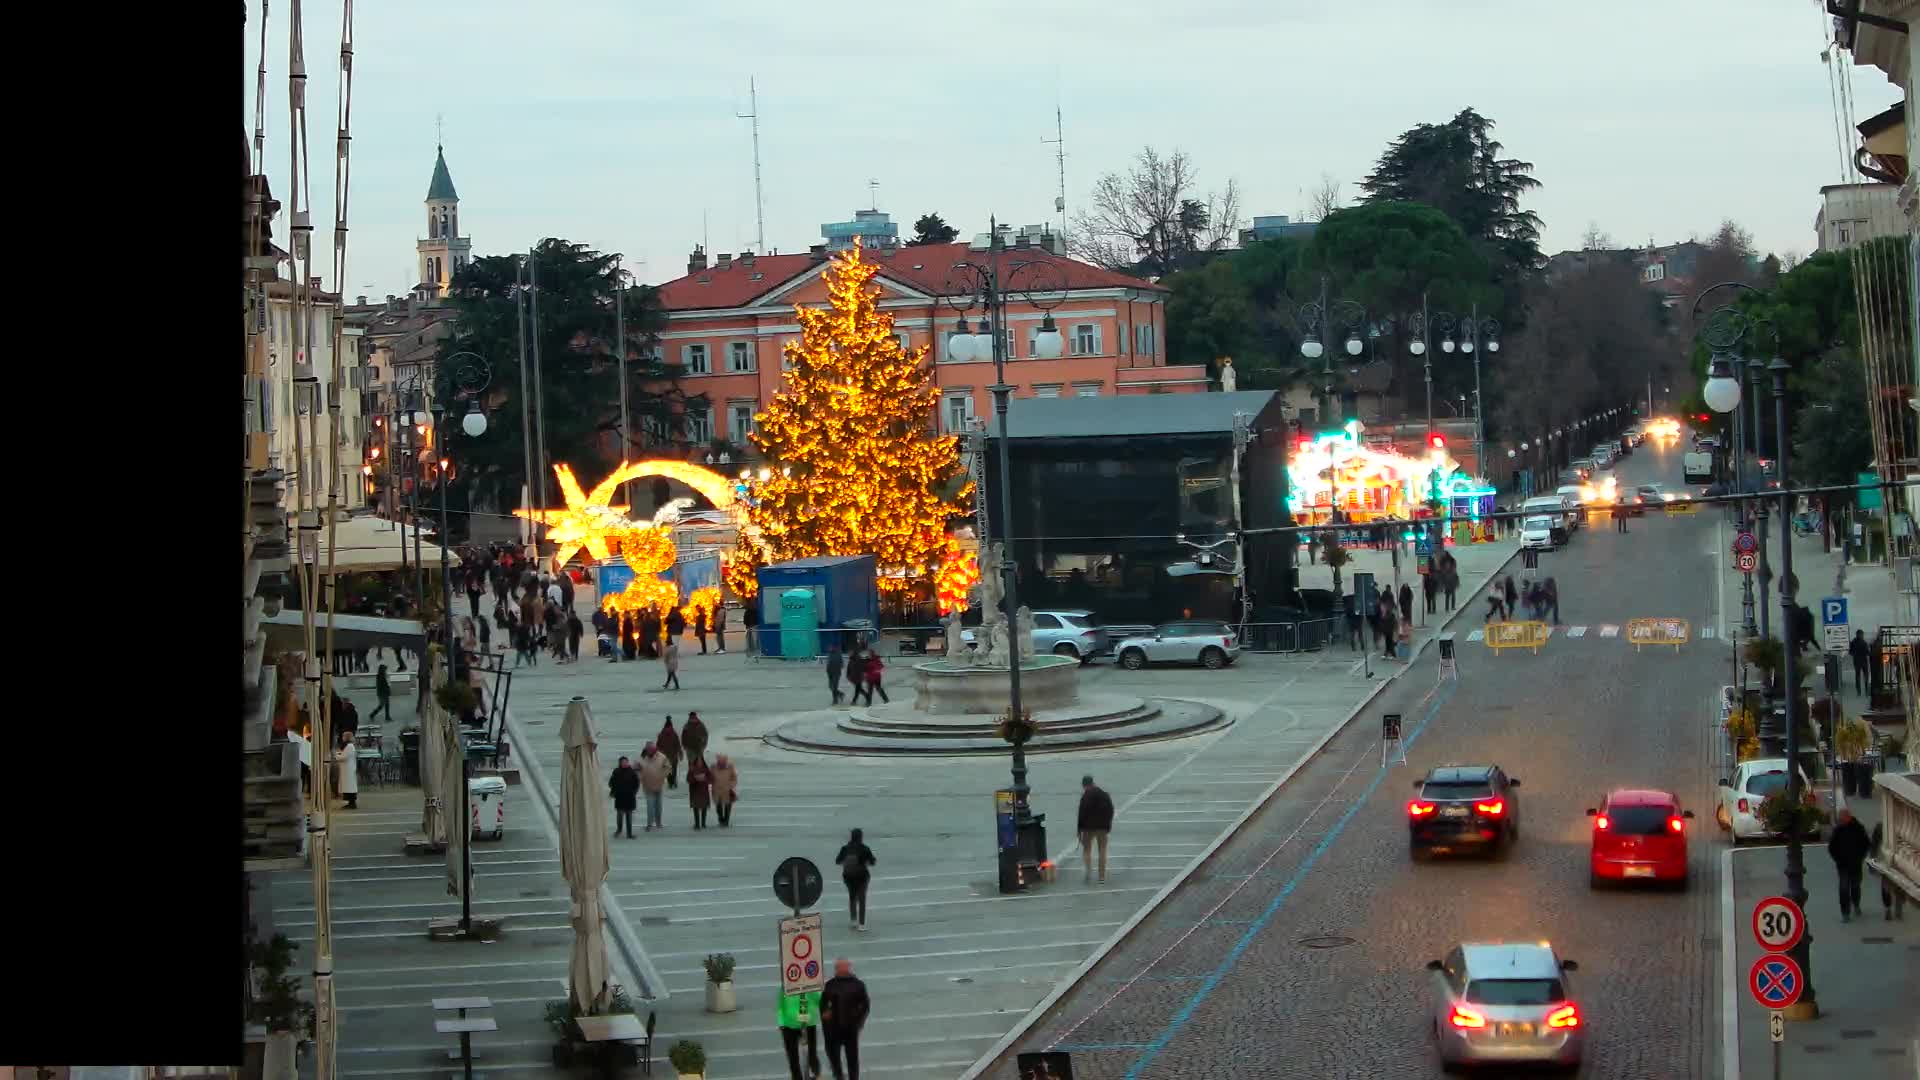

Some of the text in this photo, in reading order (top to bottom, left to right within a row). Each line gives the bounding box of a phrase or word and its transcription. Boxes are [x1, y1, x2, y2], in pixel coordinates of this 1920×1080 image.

[1742, 557, 1752, 566] 20
[1827, 602, 1842, 621] P
[1762, 912, 1792, 937] 30
